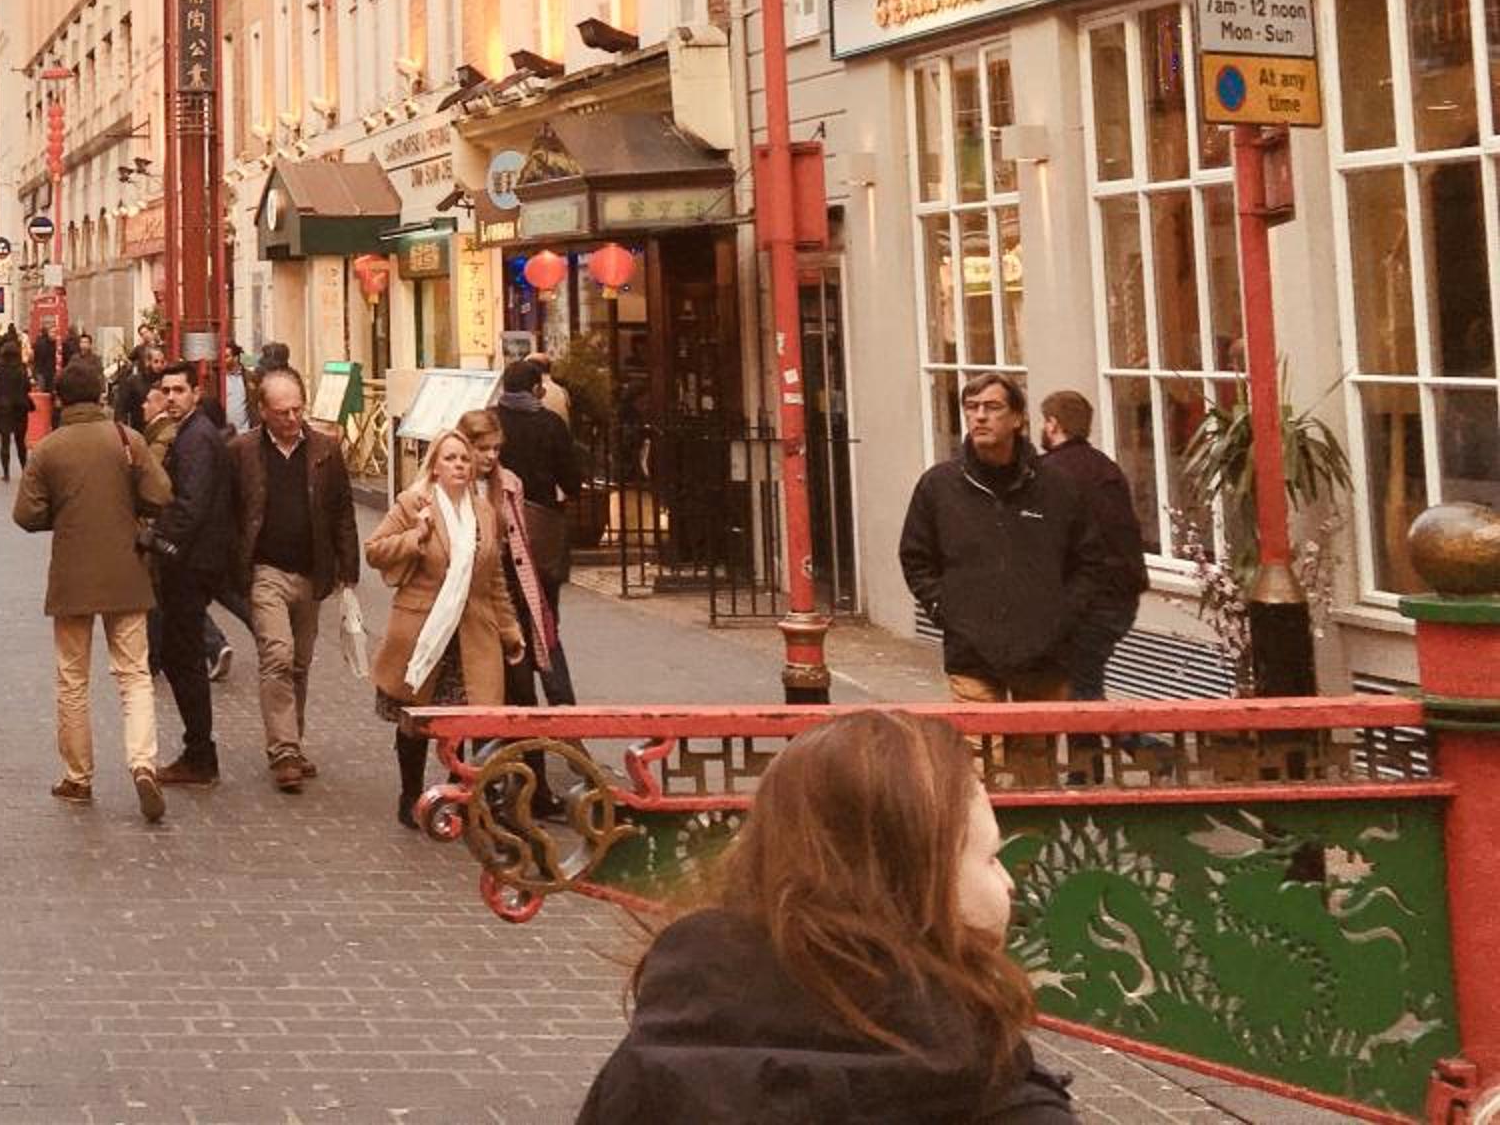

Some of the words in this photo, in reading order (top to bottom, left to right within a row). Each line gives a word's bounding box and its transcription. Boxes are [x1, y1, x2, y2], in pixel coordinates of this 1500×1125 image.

[1271, 2, 1307, 20] noon
[1221, 21, 1253, 42] Mon
[1265, 24, 1294, 44] Sun
[1258, 68, 1278, 87] At
[1281, 71, 1306, 91] any
[1267, 93, 1301, 113] time
